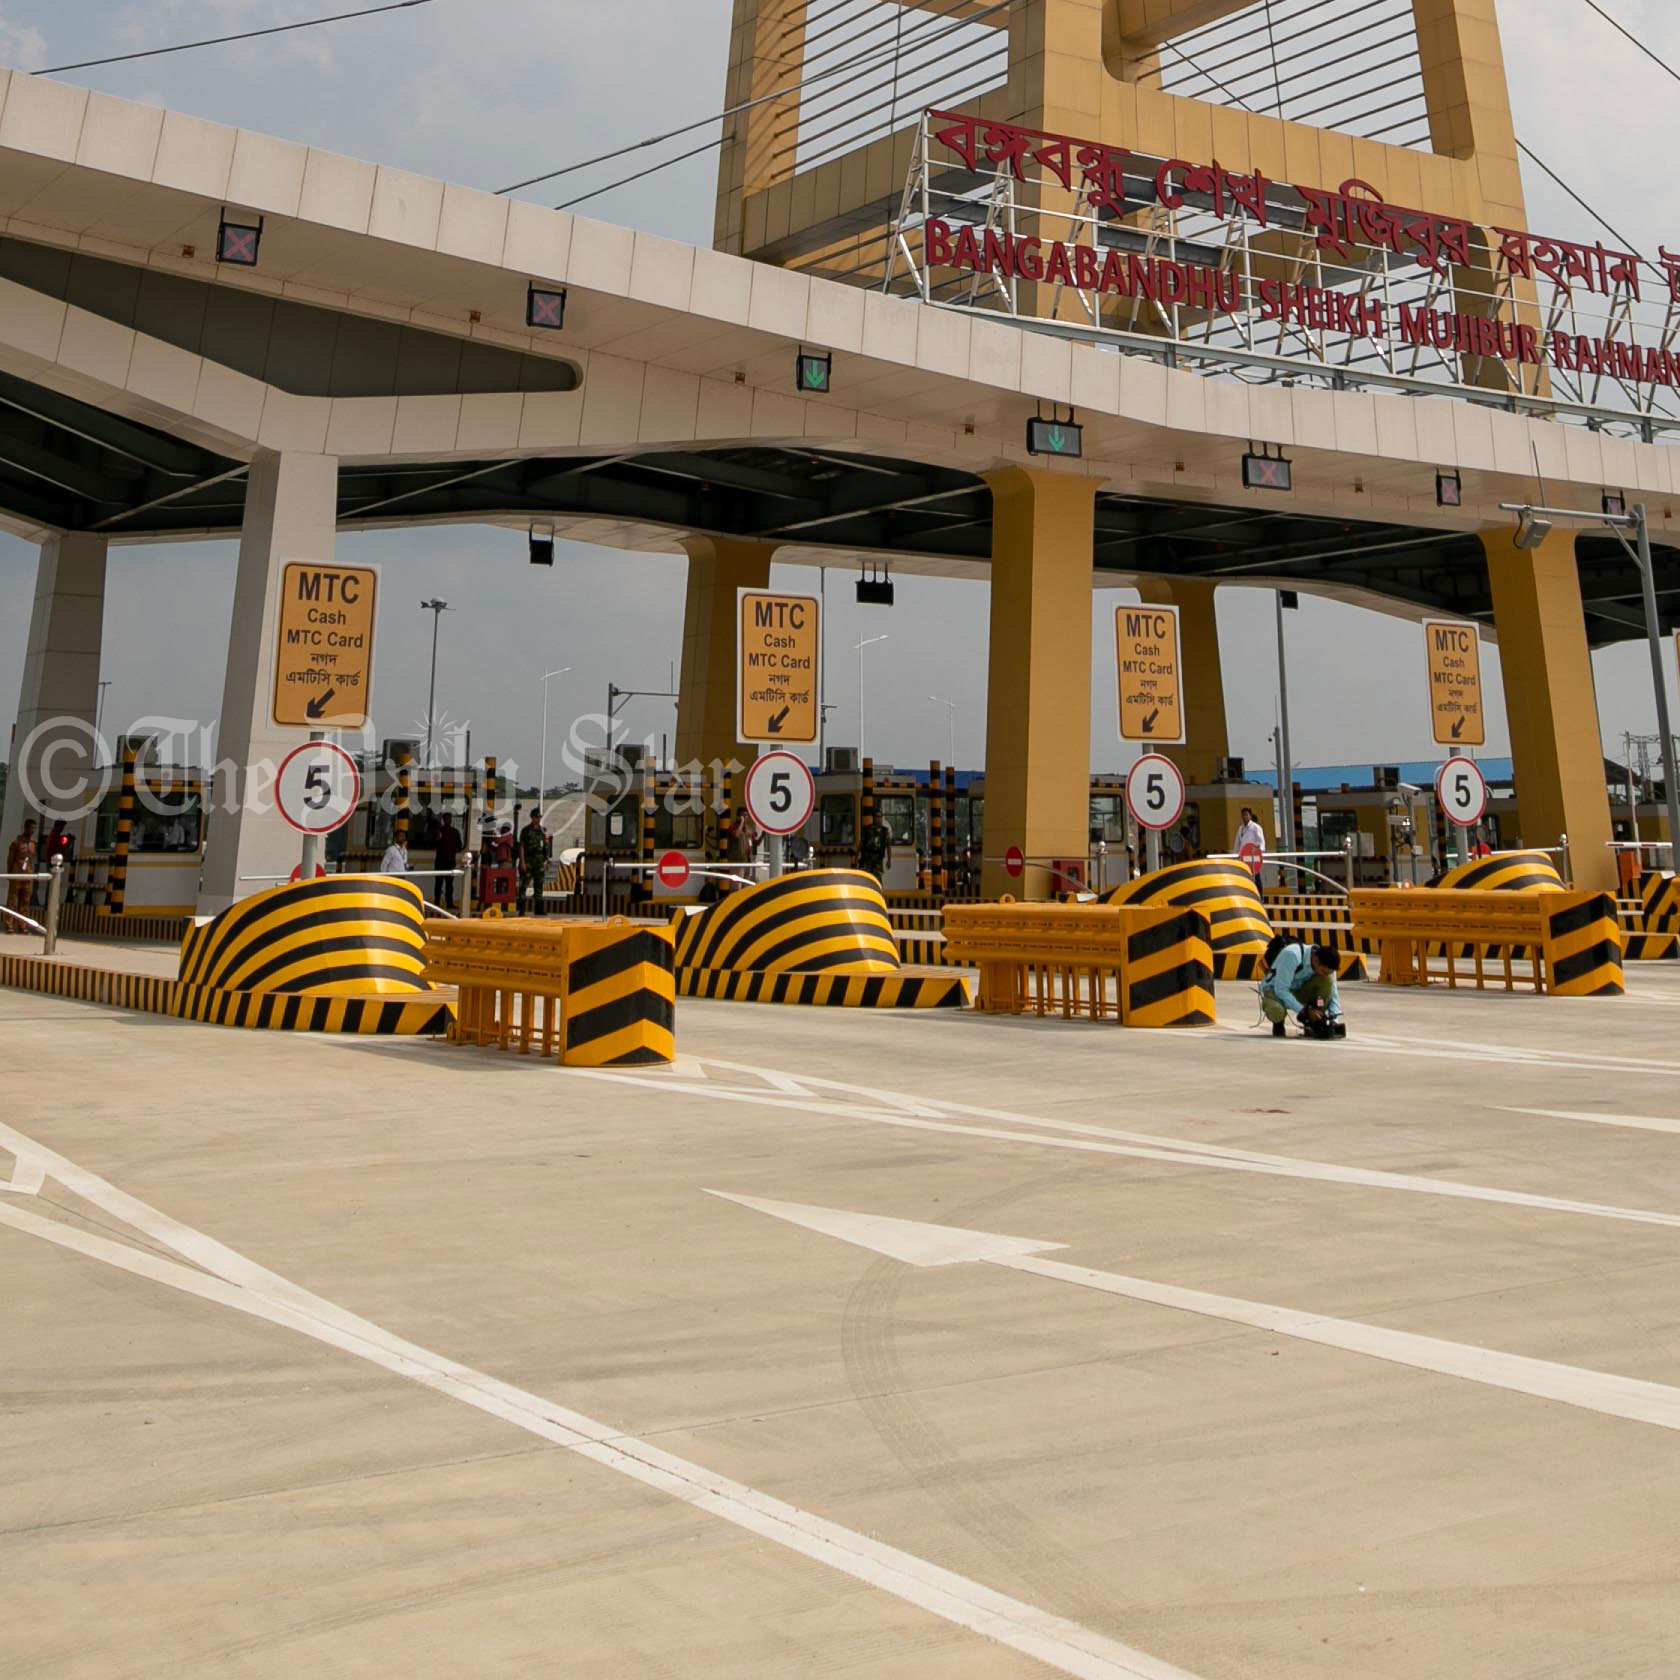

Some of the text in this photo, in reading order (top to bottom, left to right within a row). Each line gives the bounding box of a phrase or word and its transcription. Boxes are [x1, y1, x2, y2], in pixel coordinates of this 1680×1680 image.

[926, 108, 1132, 219] বঙ্গবন্ধু
[1155, 158, 1272, 228] শেখ
[1294, 179, 1472, 275] মুজিবুর
[1492, 227, 1642, 303] রহমান
[925, 218, 1240, 313] BANGABANDHU
[1260, 279, 1383, 338] SHEIKH
[1399, 303, 1541, 365] MUJIBUR
[298, 572, 359, 604] MTC
[308, 608, 346, 624] Cash
[756, 601, 804, 629] MTC
[1126, 614, 1165, 639] MTC
[288, 629, 363, 648] MTC Card
[764, 634, 795, 648] Cash
[1435, 629, 1468, 652] MTC
[1135, 643, 1159, 656] Cash
[310, 653, 338, 666] নগদ
[749, 653, 810, 669] MTC Card
[1123, 660, 1172, 674] MTC Card
[1443, 656, 1464, 668] Cash
[286, 668, 360, 686] এমটিসি কার্ড
[768, 675, 790, 685] নগদ
[1434, 672, 1476, 685] MTC Card
[750, 688, 809, 703] এমটিসি কার্ড
[304, 766, 331, 809] 5
[770, 773, 791, 812] 5
[1147, 774, 1165, 810] 5
[1456, 775, 1470, 807] 5
